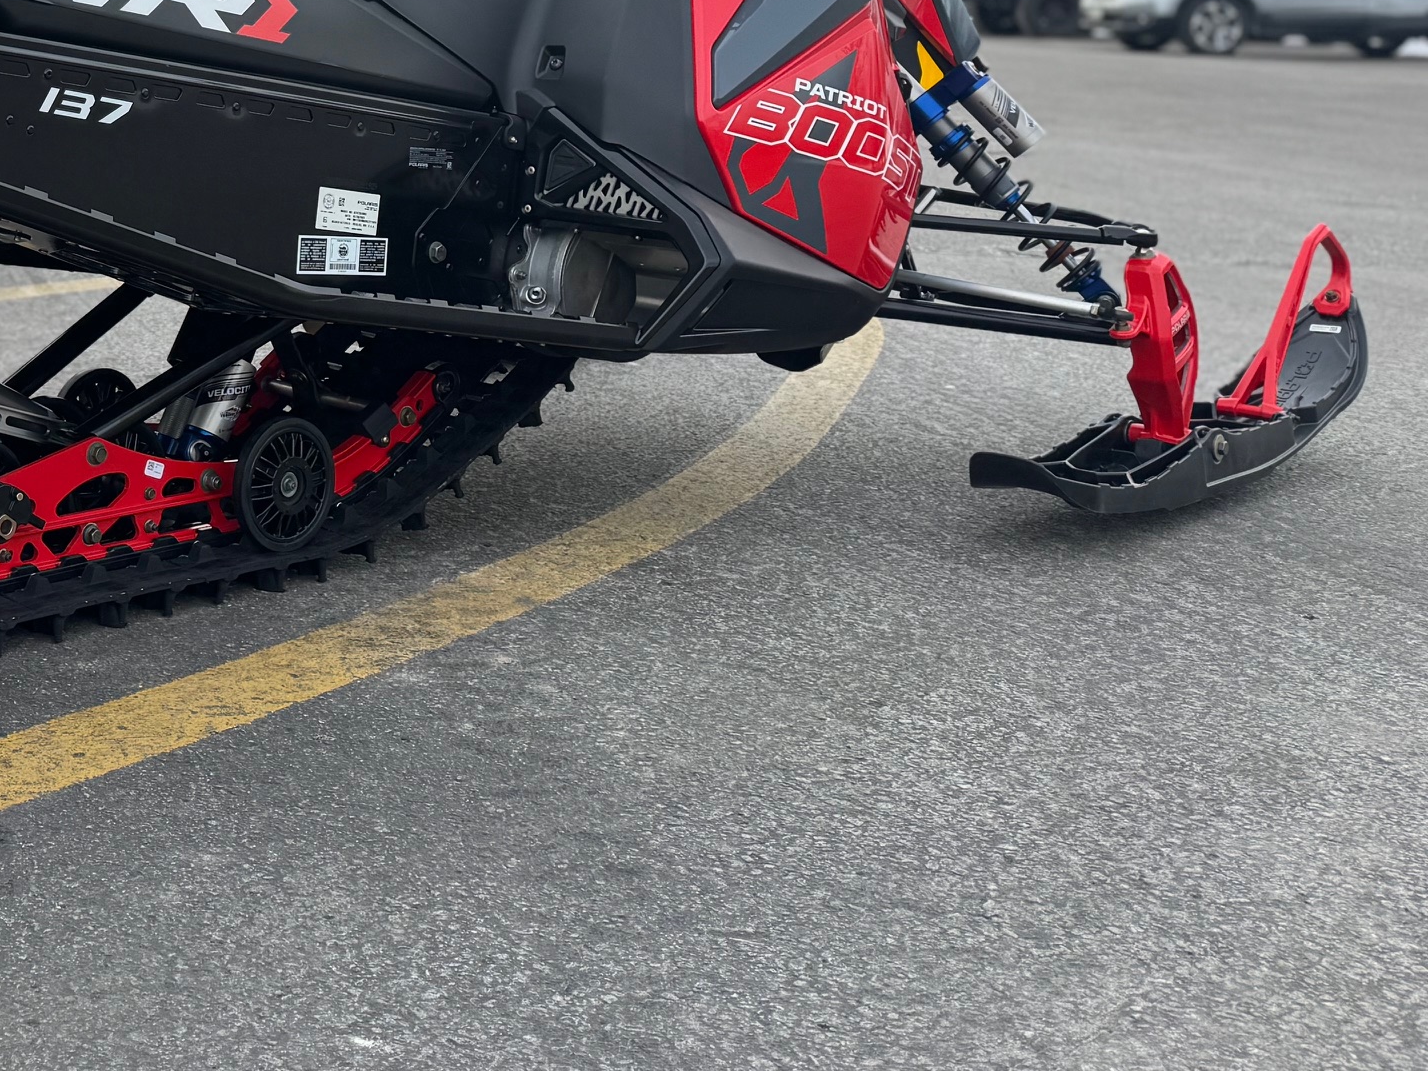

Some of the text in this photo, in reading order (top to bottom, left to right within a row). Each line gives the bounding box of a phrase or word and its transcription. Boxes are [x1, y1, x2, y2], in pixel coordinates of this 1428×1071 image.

[39, 86, 134, 125] 137
[794, 77, 887, 119] PATRIOT
[723, 88, 922, 203] BOOST
